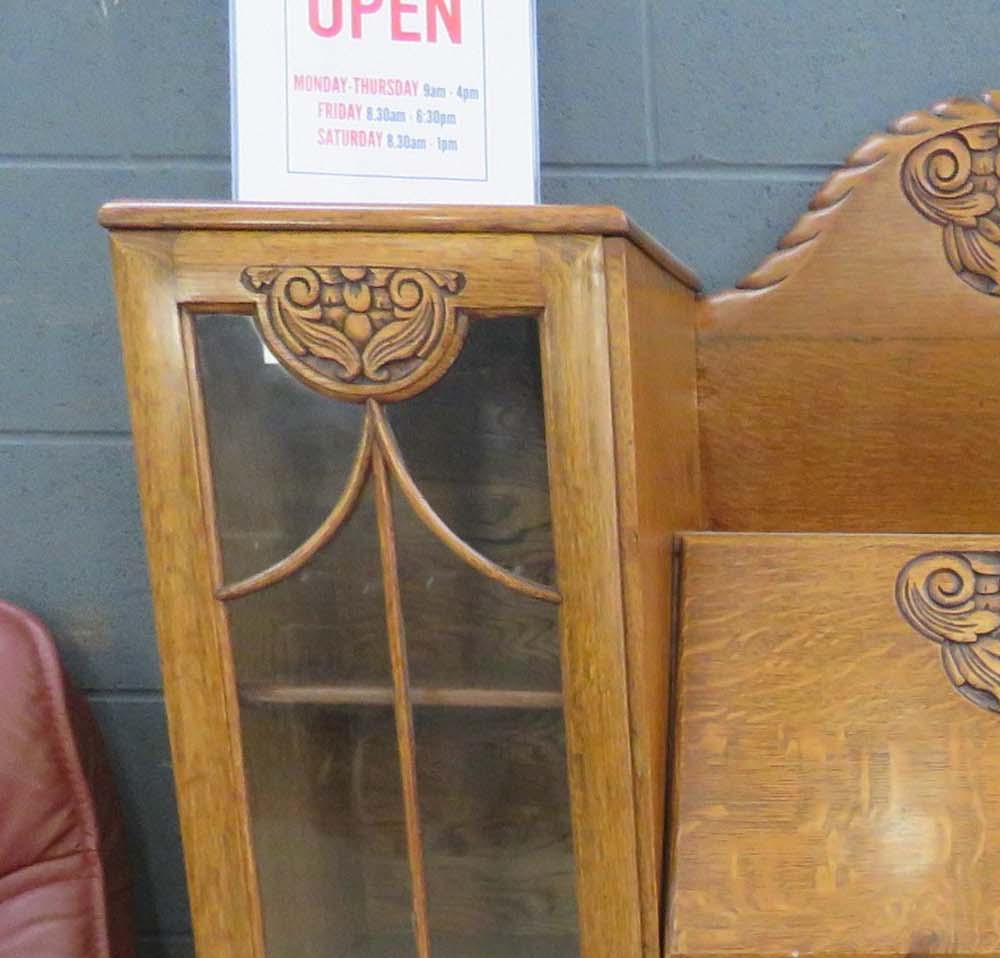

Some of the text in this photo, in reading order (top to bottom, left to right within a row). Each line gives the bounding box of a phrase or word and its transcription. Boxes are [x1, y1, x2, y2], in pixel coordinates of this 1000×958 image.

[309, 0, 462, 44] OPEN
[423, 83, 446, 99] 9am
[456, 85, 480, 102] 4pm
[317, 102, 363, 121] FRIDAY
[366, 106, 406, 123] 8.30am
[317, 128, 384, 148] SATURDAY
[387, 134, 427, 150] 8.30am
[437, 137, 458, 153] 1pm
